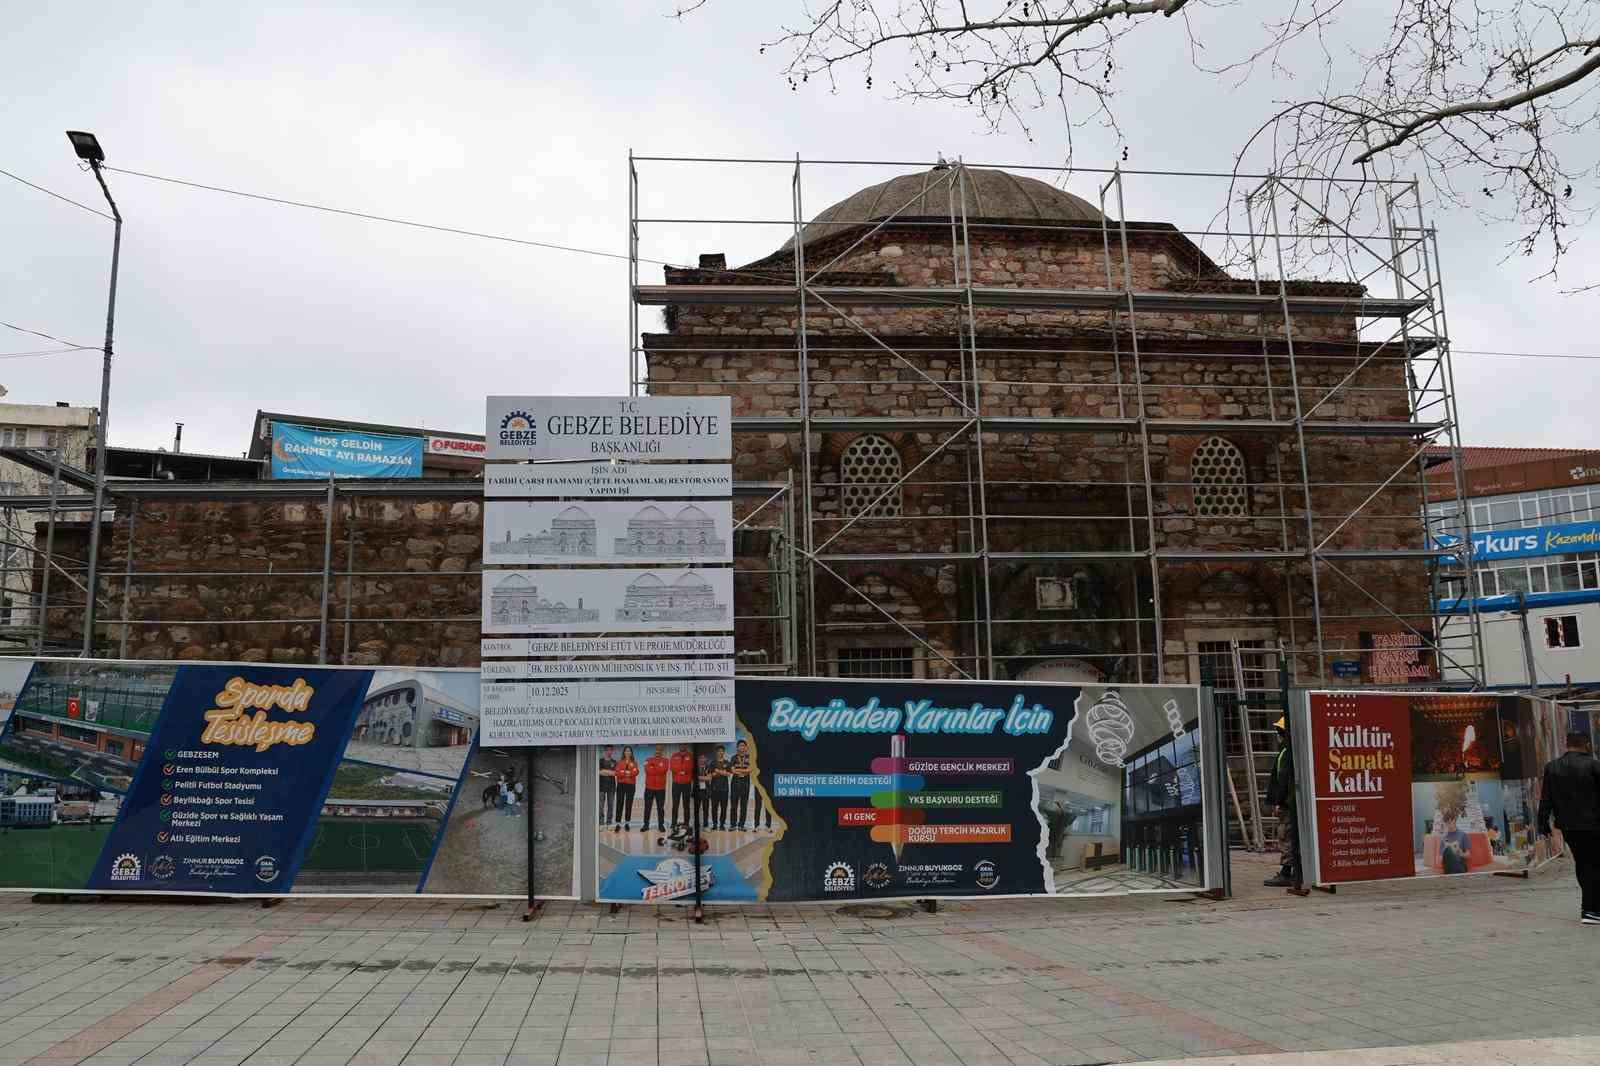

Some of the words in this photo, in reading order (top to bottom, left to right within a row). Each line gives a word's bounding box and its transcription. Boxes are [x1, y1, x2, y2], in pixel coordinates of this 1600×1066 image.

[619, 401, 639, 413] T.C.
[547, 415, 614, 435] GEBZE
[620, 412, 718, 435] BELEDİYE
[500, 430, 536, 440] GEBZE
[314, 436, 338, 448] HOŞ
[341, 437, 383, 451] GELDİN
[591, 440, 661, 454] BAŞKANLIĞI
[284, 443, 332, 458] RAHMET
[336, 450, 354, 461] AYI
[356, 453, 412, 466] RAMAZAN
[612, 466, 628, 474] ADI
[546, 477, 583, 485] HAMAMI
[668, 476, 729, 484] RESTORASYON
[532, 642, 560, 652] GEBZE
[610, 640, 632, 650] ETÜT
[634, 642, 646, 650] VE
[646, 641, 672, 650] PROJE
[532, 664, 542, 672] HK
[544, 664, 602, 672] RESTORASYON
[602, 663, 654, 672] MÜHENDİSLİK
[656, 664, 664, 672] VE
[694, 685, 707, 694] 450
[708, 683, 726, 694] GÜN
[215, 676, 314, 712] Sporda
[768, 697, 903, 741] Bugünden
[904, 699, 1005, 734] Yarınlar
[1002, 694, 1054, 736] İçin
[1328, 725, 1394, 752] Kültür,
[177, 751, 219, 759] GEBZESEM
[1328, 748, 1394, 770] Sanata
[176, 766, 194, 774] Eren
[195, 766, 220, 774] Bülbül
[221, 767, 238, 776] Spor
[240, 767, 279, 776] Kompleksi
[908, 762, 938, 772] GÜZİDE
[940, 762, 974, 772] GENÇLİK
[976, 762, 1010, 772] MERKEZİ
[778, 774, 827, 784] ÜNİVERSİTE
[828, 774, 856, 784] EĞİTİM
[858, 774, 892, 784] DESTEĞİ
[1330, 768, 1383, 793] Katkı
[175, 781, 197, 790] Pelitli
[198, 781, 223, 790] Futbol
[224, 782, 262, 792] Stadyumu
[778, 788, 788, 796] 10
[788, 787, 804, 796] BİN
[804, 788, 815, 796] TL
[174, 796, 214, 806] Beylikbağı
[214, 796, 234, 806] Spor
[234, 797, 255, 806] Tesisi
[908, 796, 924, 804] YKS
[926, 796, 964, 805] BAŞVURU
[966, 794, 998, 804] DESTEĞİ
[172, 811, 199, 820] Güzide
[200, 812, 218, 822] Spor
[259, 813, 284, 822] Yaşam
[844, 813, 852, 821] 41
[854, 813, 876, 822] GENÇ
[171, 820, 201, 828] Merkezi
[908, 826, 938, 836] DOĞRU
[940, 826, 967, 835] TERCİH
[968, 826, 1007, 834] HAZIRLIK
[170, 835, 184, 843] Atlı
[186, 834, 210, 844] Eğitim
[211, 836, 241, 844] Merkezi
[908, 834, 936, 842] KURSU
[112, 868, 140, 876] GEBZE
[824, 878, 855, 886] GEBZE
